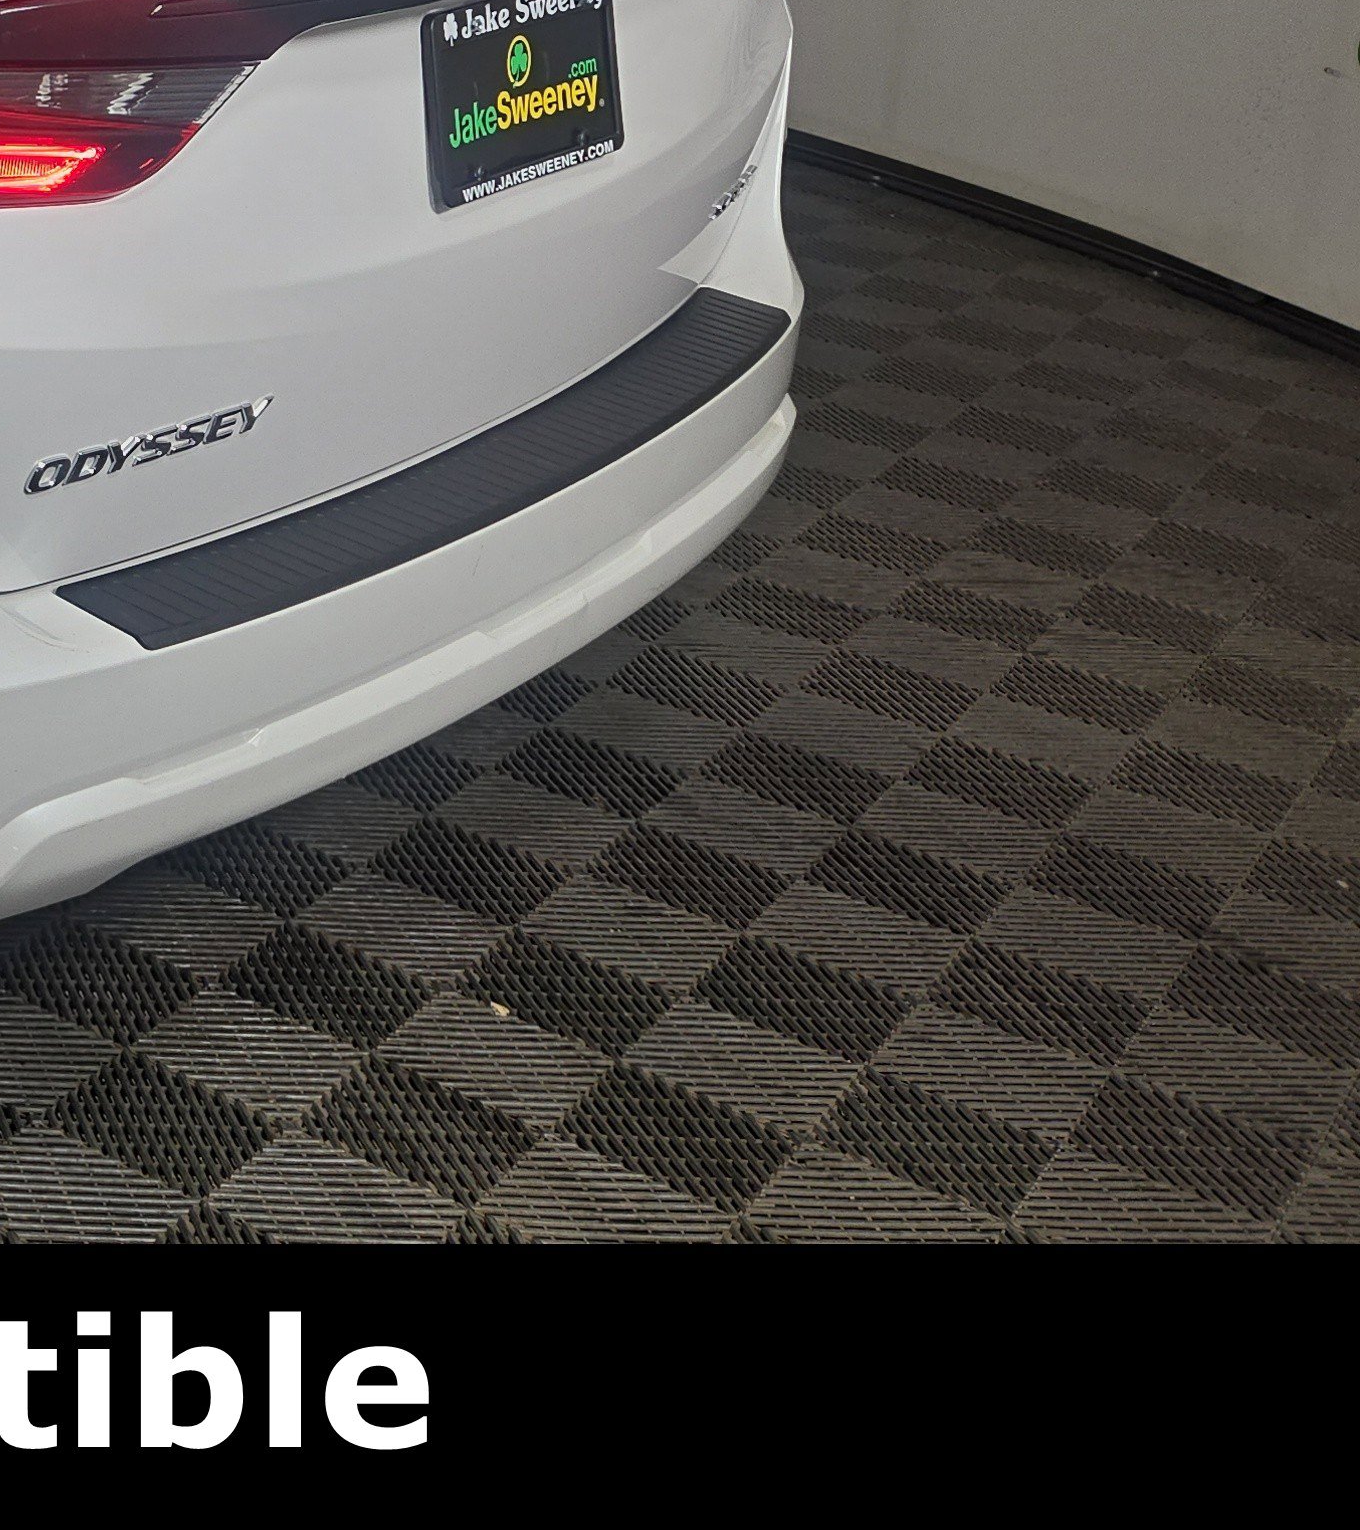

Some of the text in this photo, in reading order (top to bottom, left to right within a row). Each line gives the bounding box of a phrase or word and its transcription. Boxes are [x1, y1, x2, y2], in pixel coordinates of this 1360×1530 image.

[461, 3, 511, 39] Jake
[462, 139, 614, 203] WWW.JAKESWEENEY.COM
[23, 392, 274, 494] ODYSSEY
